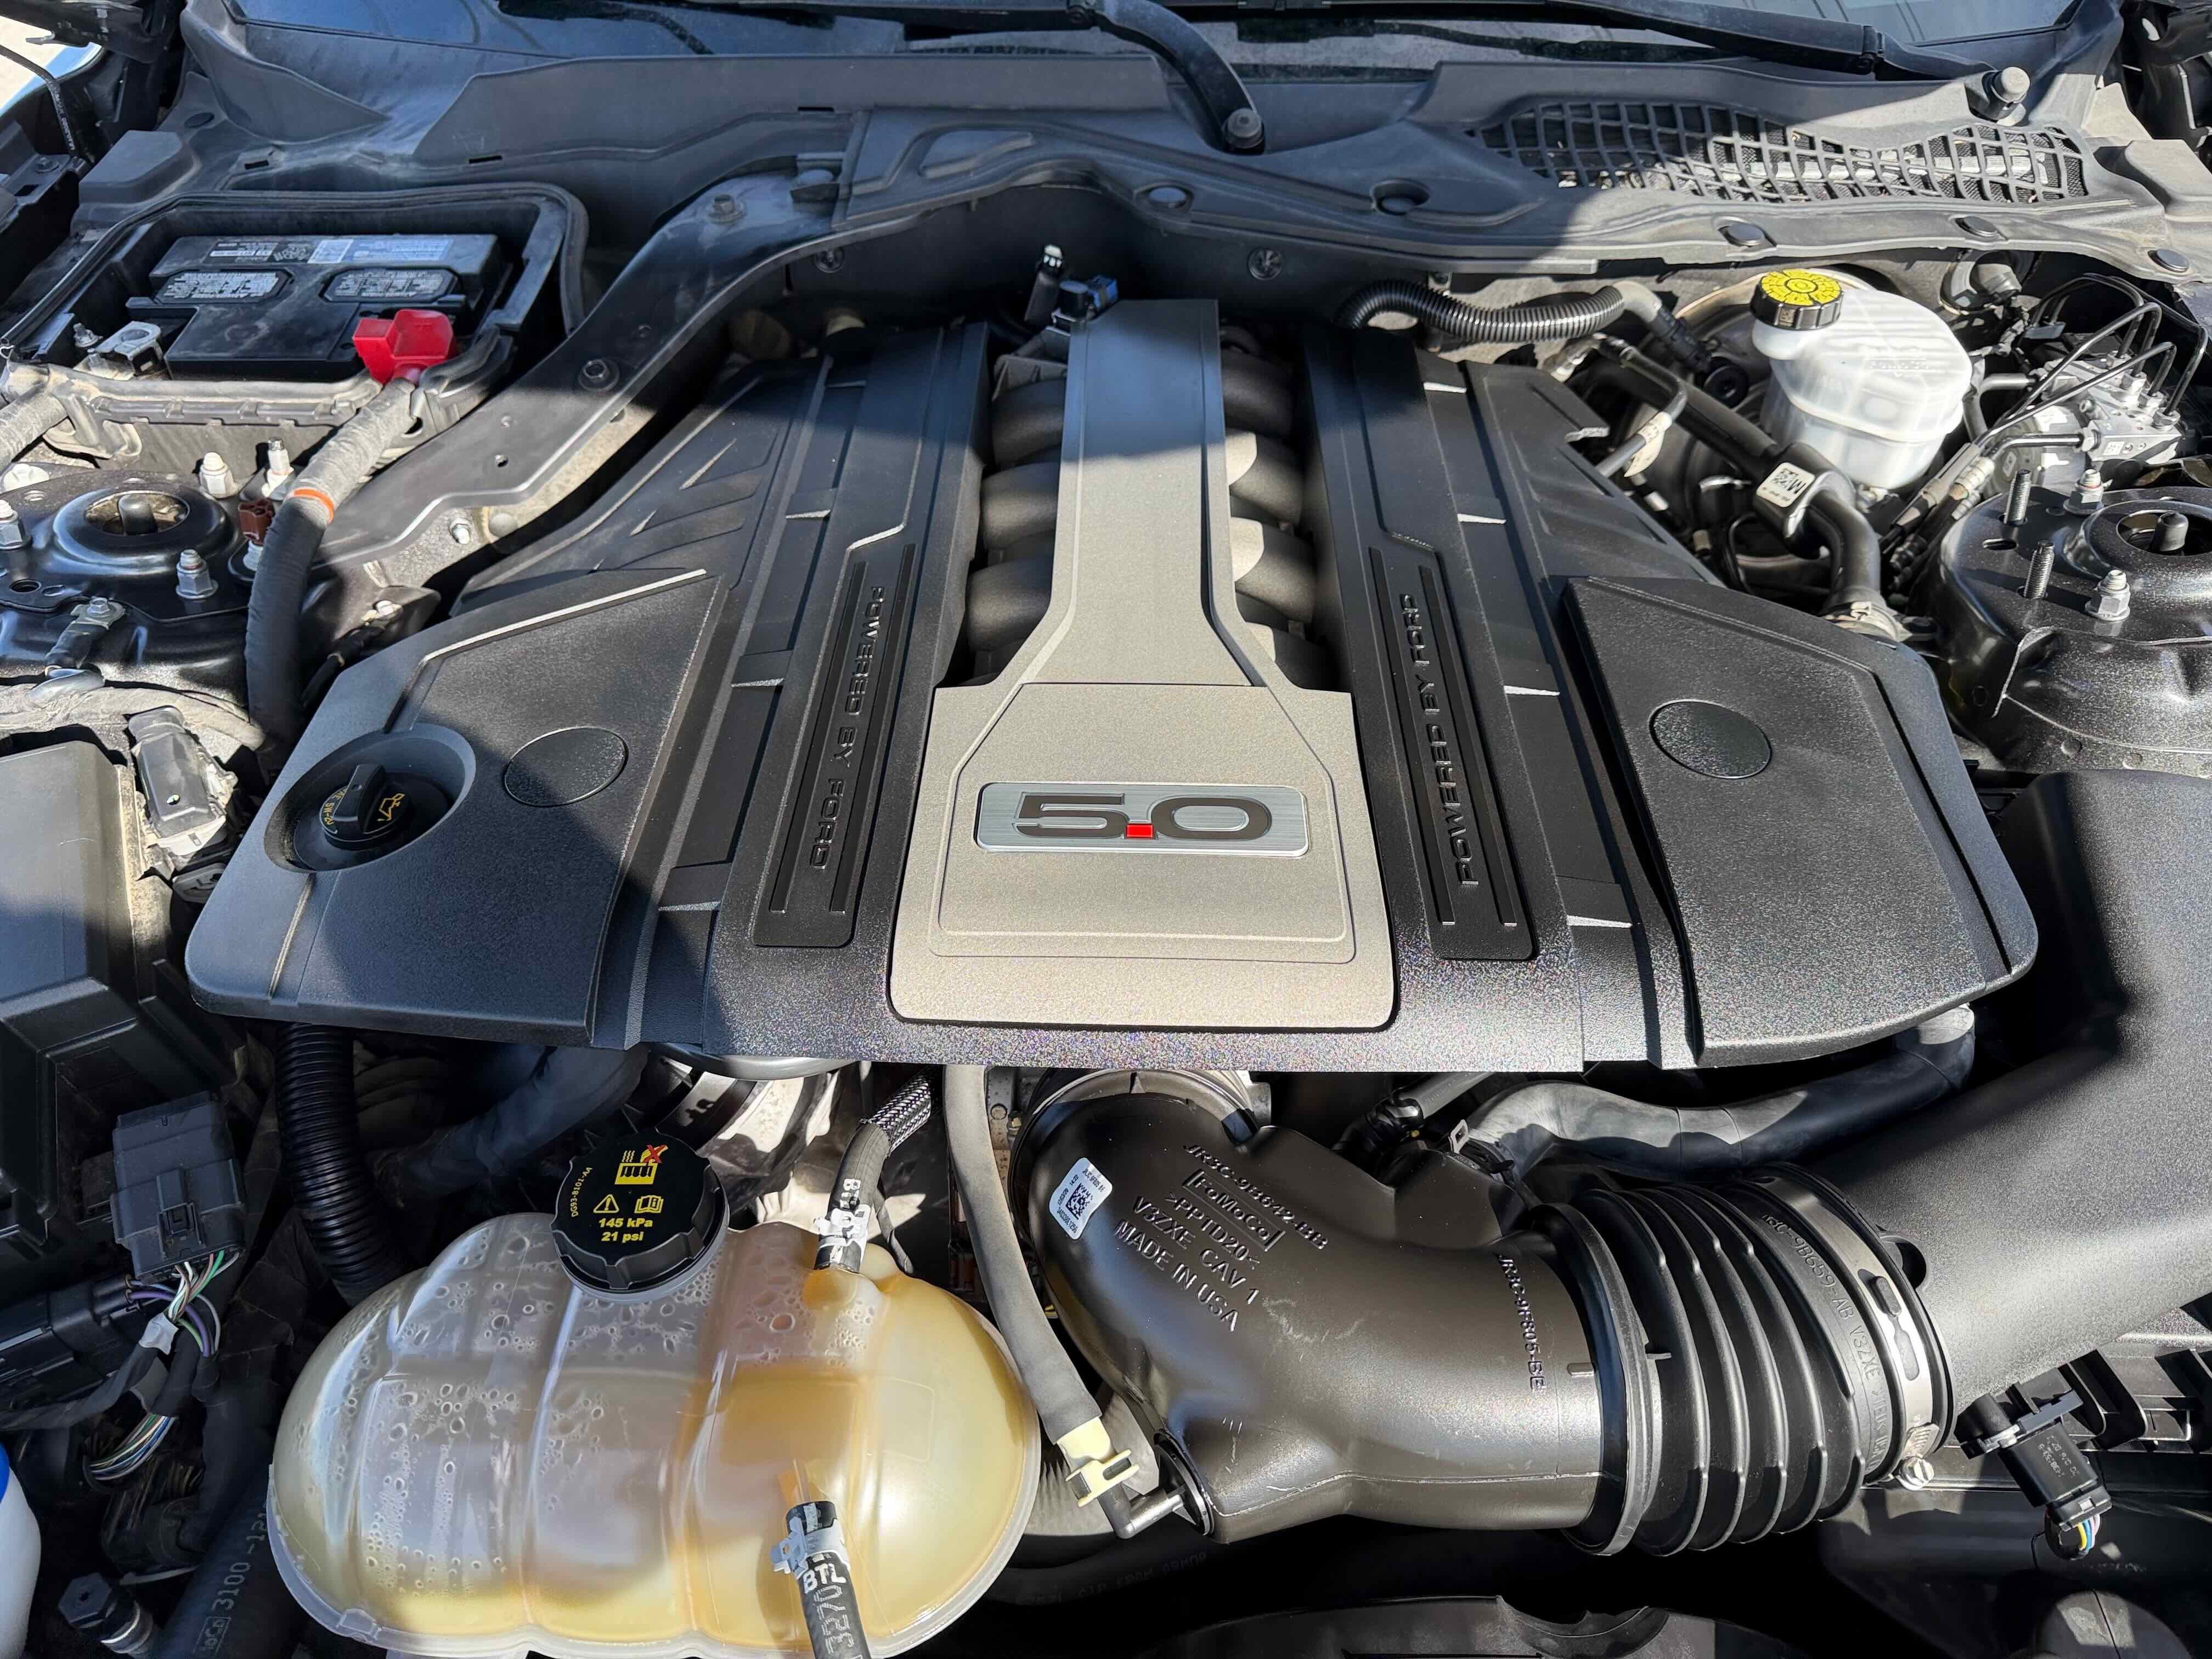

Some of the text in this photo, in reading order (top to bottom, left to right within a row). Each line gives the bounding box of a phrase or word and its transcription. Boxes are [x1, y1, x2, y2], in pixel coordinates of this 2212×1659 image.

[810, 586, 885, 870] POWERED BY FORD
[1400, 593, 1479, 886] POWERED BY FORD
[1012, 792, 1273, 840] 5.0
[570, 1166, 593, 1218] DG93-8101-AA
[1193, 1177, 1271, 1242] FoMoCo
[599, 1217, 653, 1228] 145 kPa
[601, 1231, 644, 1243] 21 psi
[1133, 1195, 1259, 1305] V3ZXE CAV 1
[1115, 1219, 1238, 1332] MADE IN USA
[1497, 1254, 1546, 1394] JR3C-9F805-BE
[1849, 1324, 1881, 1381] V3ZXE
[211, 1562, 251, 1611] 3100
[802, 1562, 847, 1594] BTL
